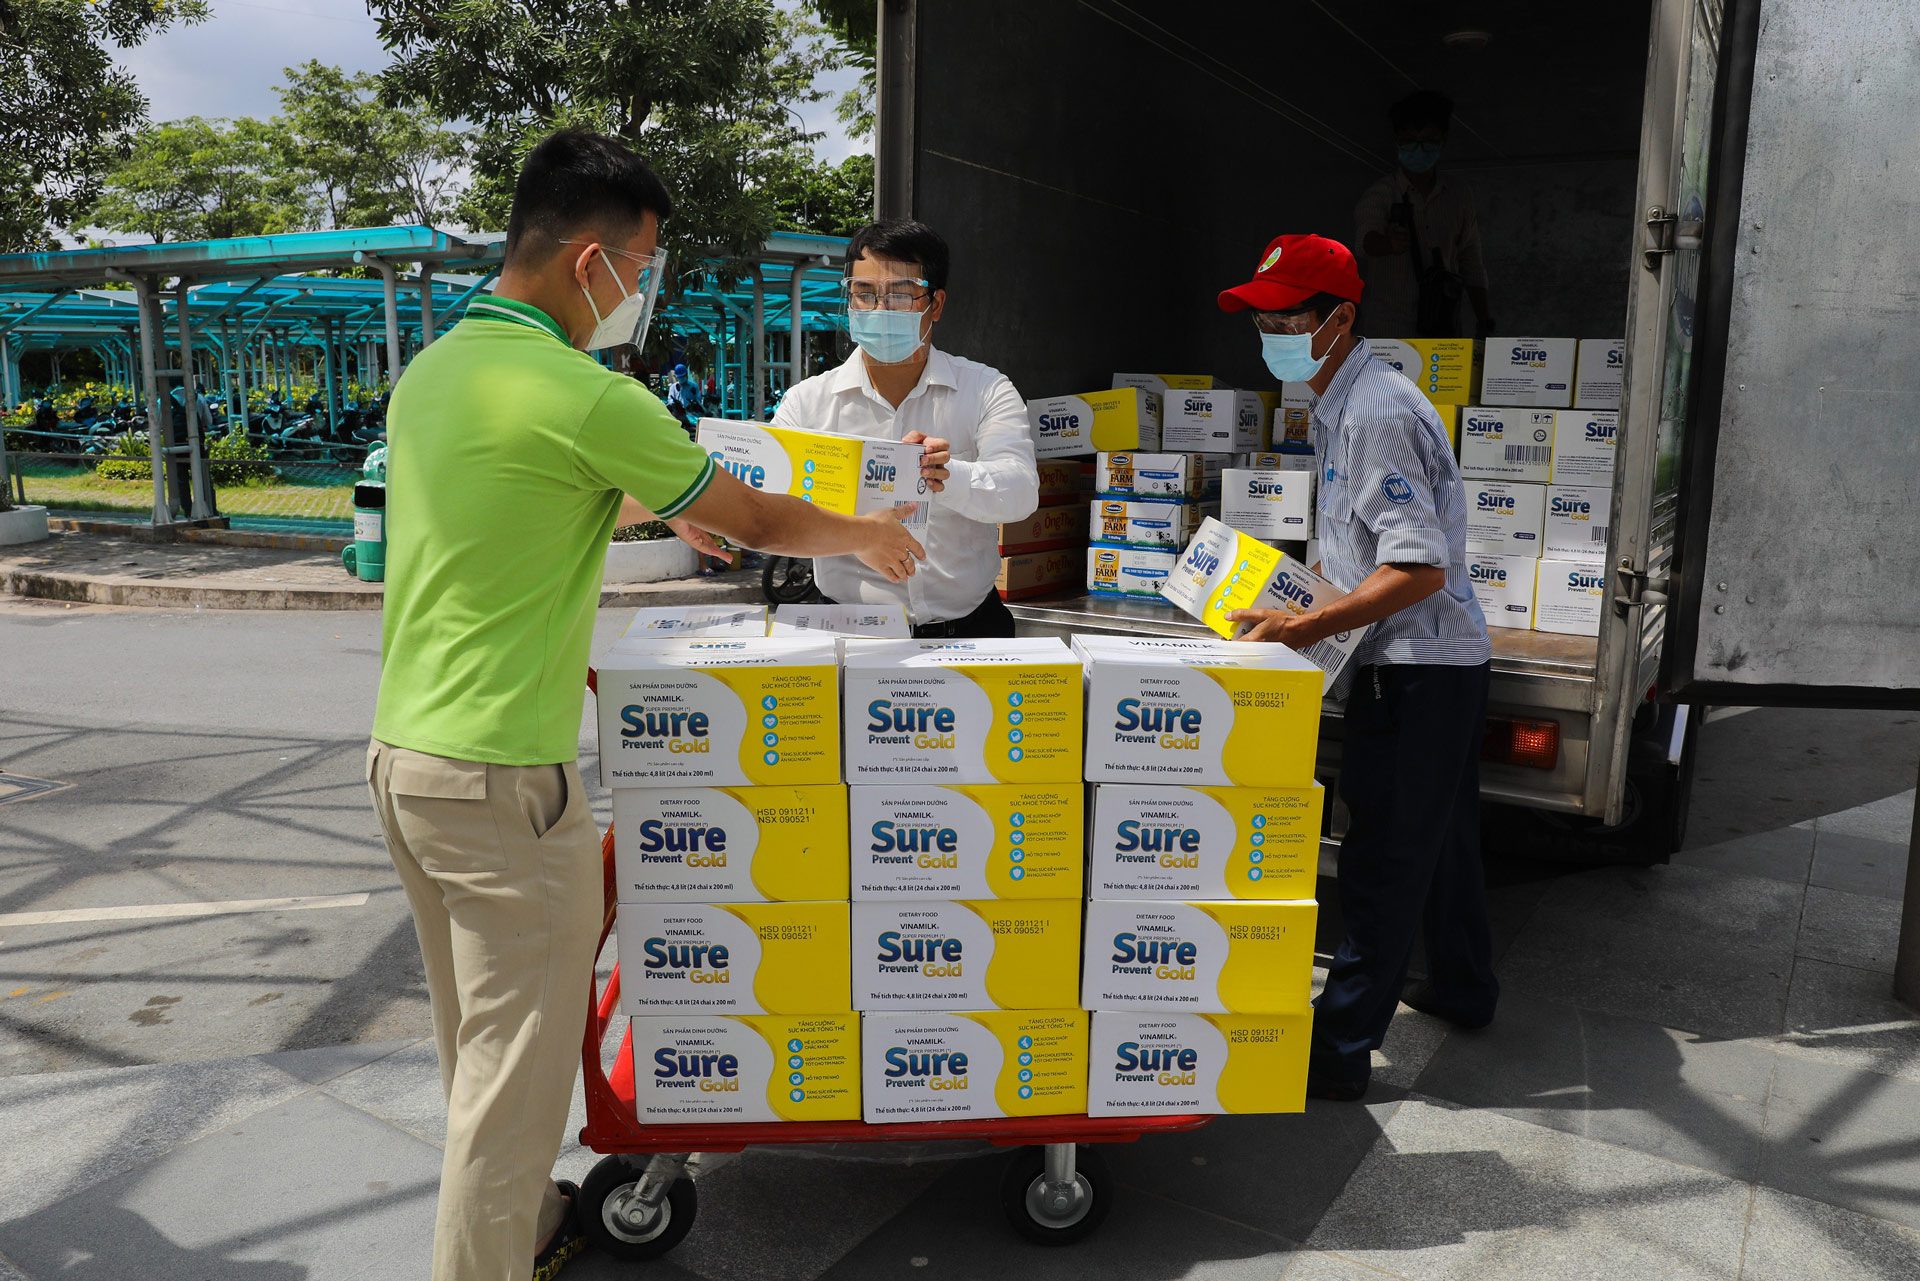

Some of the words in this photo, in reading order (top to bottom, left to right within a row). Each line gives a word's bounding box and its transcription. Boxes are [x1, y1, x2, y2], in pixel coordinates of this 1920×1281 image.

[1511, 347, 1546, 361] Sure
[1184, 399, 1212, 412] Sure
[1039, 414, 1079, 432] Sure
[1239, 409, 1258, 427] Sure
[1467, 418, 1503, 432] Sure
[1060, 429, 1079, 438] Gold
[865, 459, 896, 482] Sure
[1110, 474, 1133, 483] FARM
[880, 482, 894, 492] Gold
[1248, 480, 1283, 494] Sure
[1477, 492, 1515, 508] Sure
[1551, 497, 1590, 513] Sure
[1496, 507, 1514, 516] Gold
[1570, 512, 1590, 520] Gold
[1103, 522, 1126, 531] FARM
[1187, 542, 1219, 576] Sure
[1095, 569, 1117, 577] FARM
[1469, 564, 1506, 580] Sure
[1192, 571, 1209, 588] Gold
[1488, 580, 1506, 588] Gold
[1272, 572, 1313, 608] Sure
[1267, 588, 1287, 603] Prevent
[1285, 601, 1307, 615] Gold
[1234, 691, 1252, 701] HSD
[1255, 692, 1283, 701] 091121
[1255, 698, 1284, 708] 090521
[621, 705, 709, 738] Sure
[868, 699, 955, 733] Sure
[1115, 698, 1202, 733] Sure
[622, 739, 664, 749] Prevent
[668, 738, 709, 754] Gold
[869, 735, 910, 744] Prevent
[914, 734, 955, 749] Gold
[1115, 733, 1156, 744] Prevent
[1160, 734, 1200, 750] Gold
[756, 815, 777, 823] NSX
[757, 808, 776, 817] HSD
[779, 808, 809, 817] 091121
[640, 820, 726, 852] Sure
[871, 820, 958, 853] Sure
[1115, 820, 1200, 852] Sure
[641, 854, 682, 863] Prevent
[686, 853, 726, 867] Gold
[872, 855, 913, 864] Prevent
[917, 854, 957, 868] Gold
[1116, 854, 1155, 863] Prevent
[1159, 854, 1199, 868] Gold
[992, 920, 1012, 928] HSD
[1014, 920, 1043, 928] 091121
[993, 926, 1012, 935] NSX
[1014, 926, 1043, 934] 090521
[1230, 925, 1248, 934] HSD
[1251, 926, 1279, 934] 091121
[1250, 932, 1279, 940] 090521
[643, 937, 729, 969] Sure
[877, 931, 962, 962] Sure
[1112, 932, 1197, 965] Sure
[645, 970, 685, 979] Prevent
[690, 970, 729, 983] Gold
[879, 964, 919, 973] Prevent
[923, 963, 962, 977] Gold
[1112, 965, 1152, 975] Prevent
[1156, 965, 1195, 980] Gold
[654, 1048, 738, 1077] Sure
[884, 1046, 968, 1077] Sure
[1115, 1042, 1197, 1072] Sure
[656, 1079, 695, 1088] Prevent
[699, 1078, 739, 1092] Gold
[886, 1078, 925, 1088] Prevent
[929, 1076, 968, 1091] Gold
[1115, 1073, 1154, 1082] Prevent
[1158, 1072, 1195, 1085] Gold
